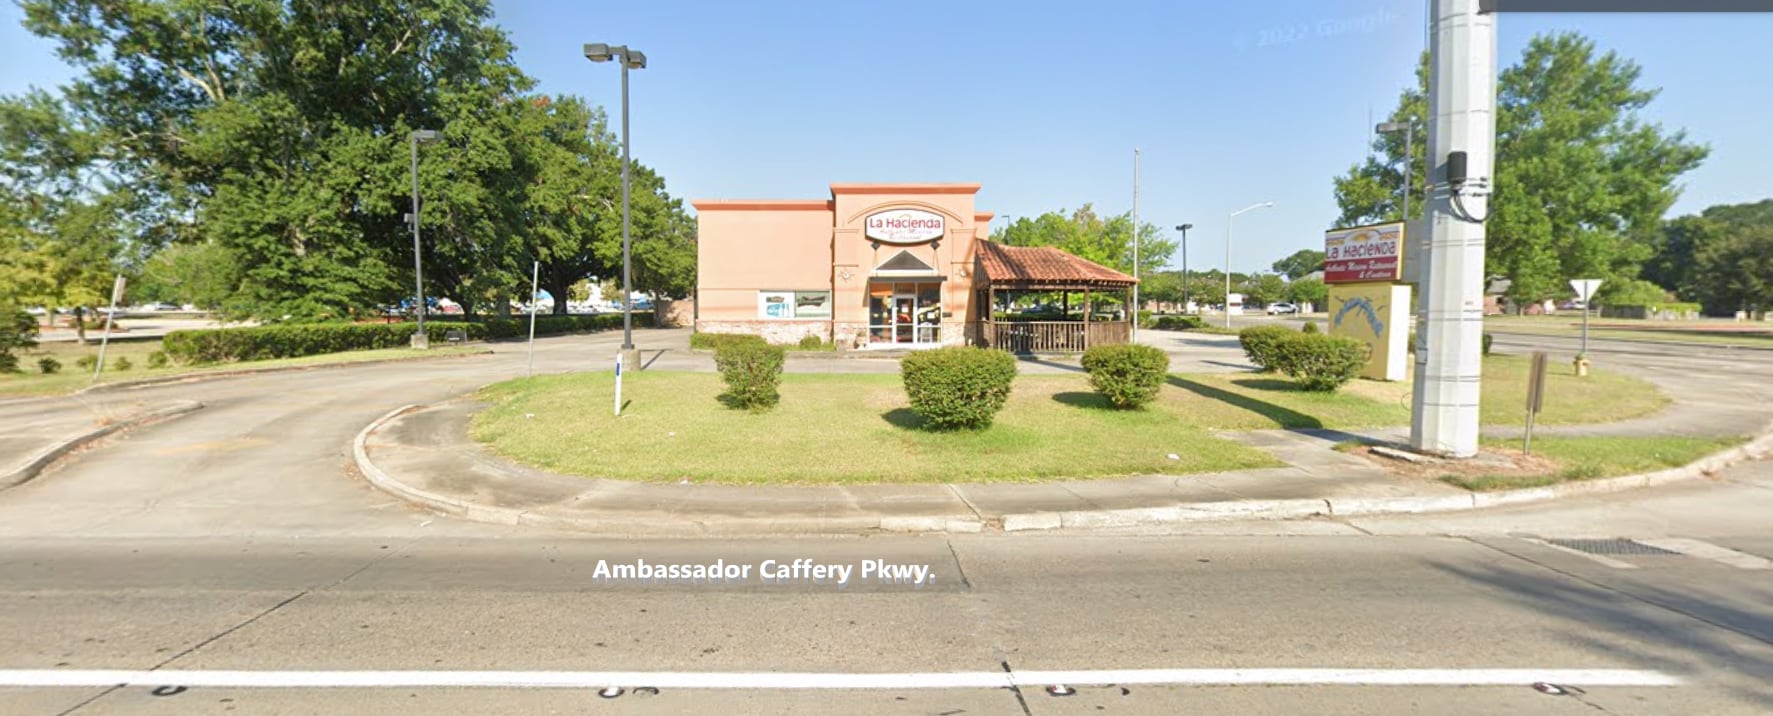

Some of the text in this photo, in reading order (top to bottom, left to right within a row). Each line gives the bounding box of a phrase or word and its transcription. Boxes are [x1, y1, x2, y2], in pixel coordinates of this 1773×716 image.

[869, 218, 941, 229] La Hacienda
[1325, 246, 1339, 259] La
